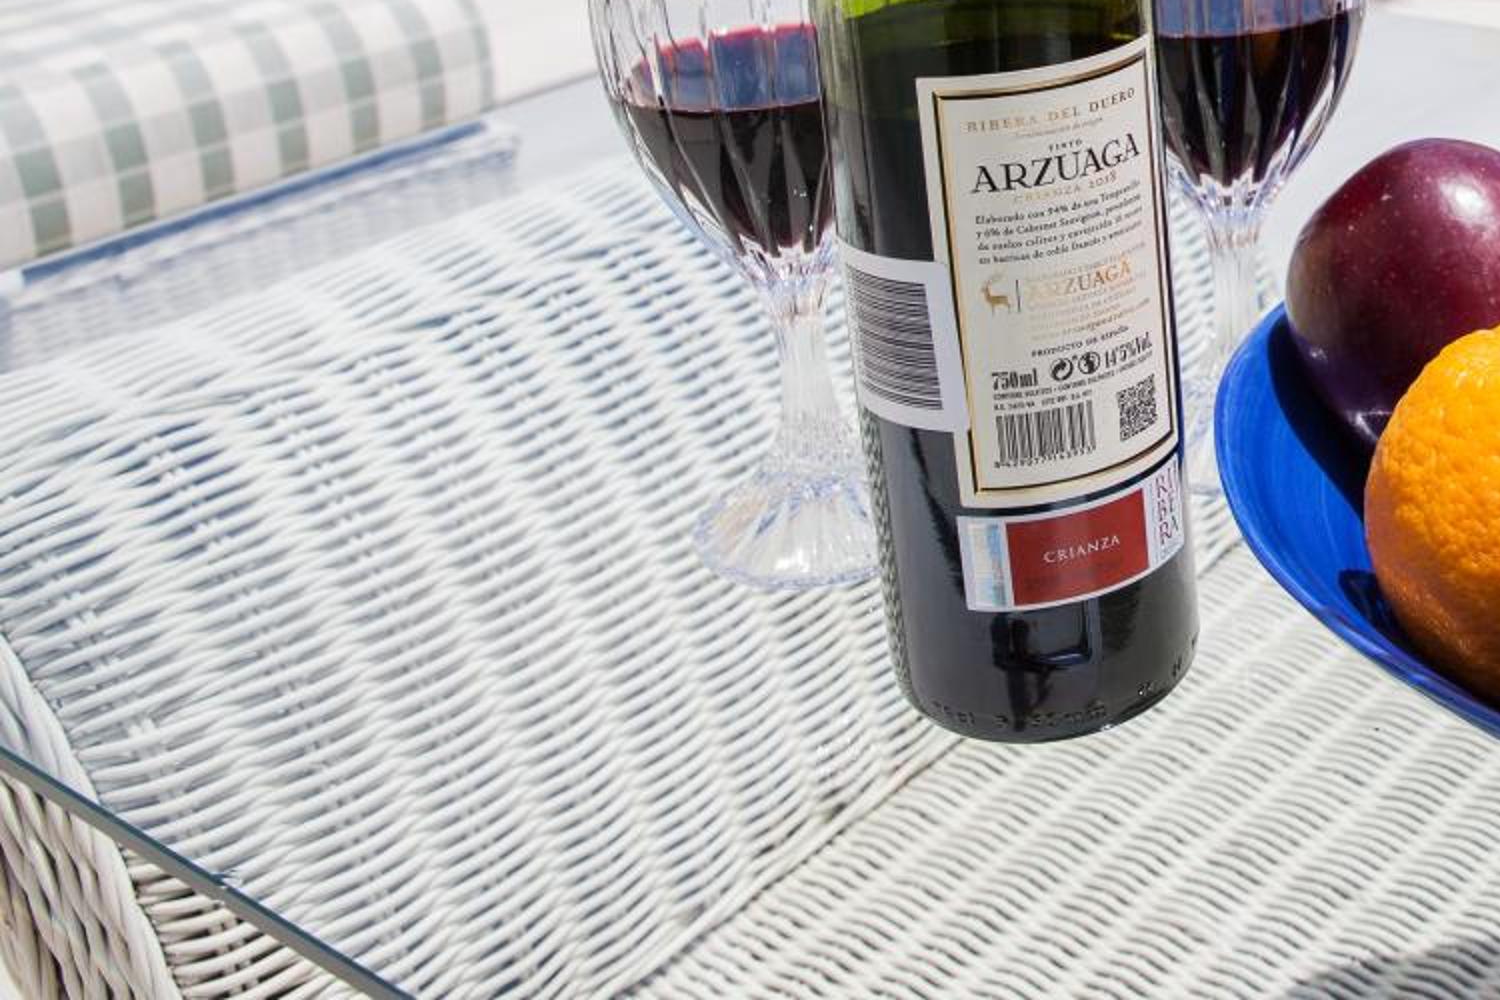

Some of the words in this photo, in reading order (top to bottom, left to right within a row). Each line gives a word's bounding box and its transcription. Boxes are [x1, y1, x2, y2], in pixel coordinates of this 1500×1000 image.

[967, 115, 1037, 133] RIBERA
[1048, 106, 1080, 121] DEL
[1089, 87, 1135, 113] DUERO
[1049, 138, 1083, 151] TINTO
[970, 133, 1140, 193] ARZUAGA
[991, 367, 1038, 391] 750ml
[1042, 534, 1121, 563] CRIANZA
